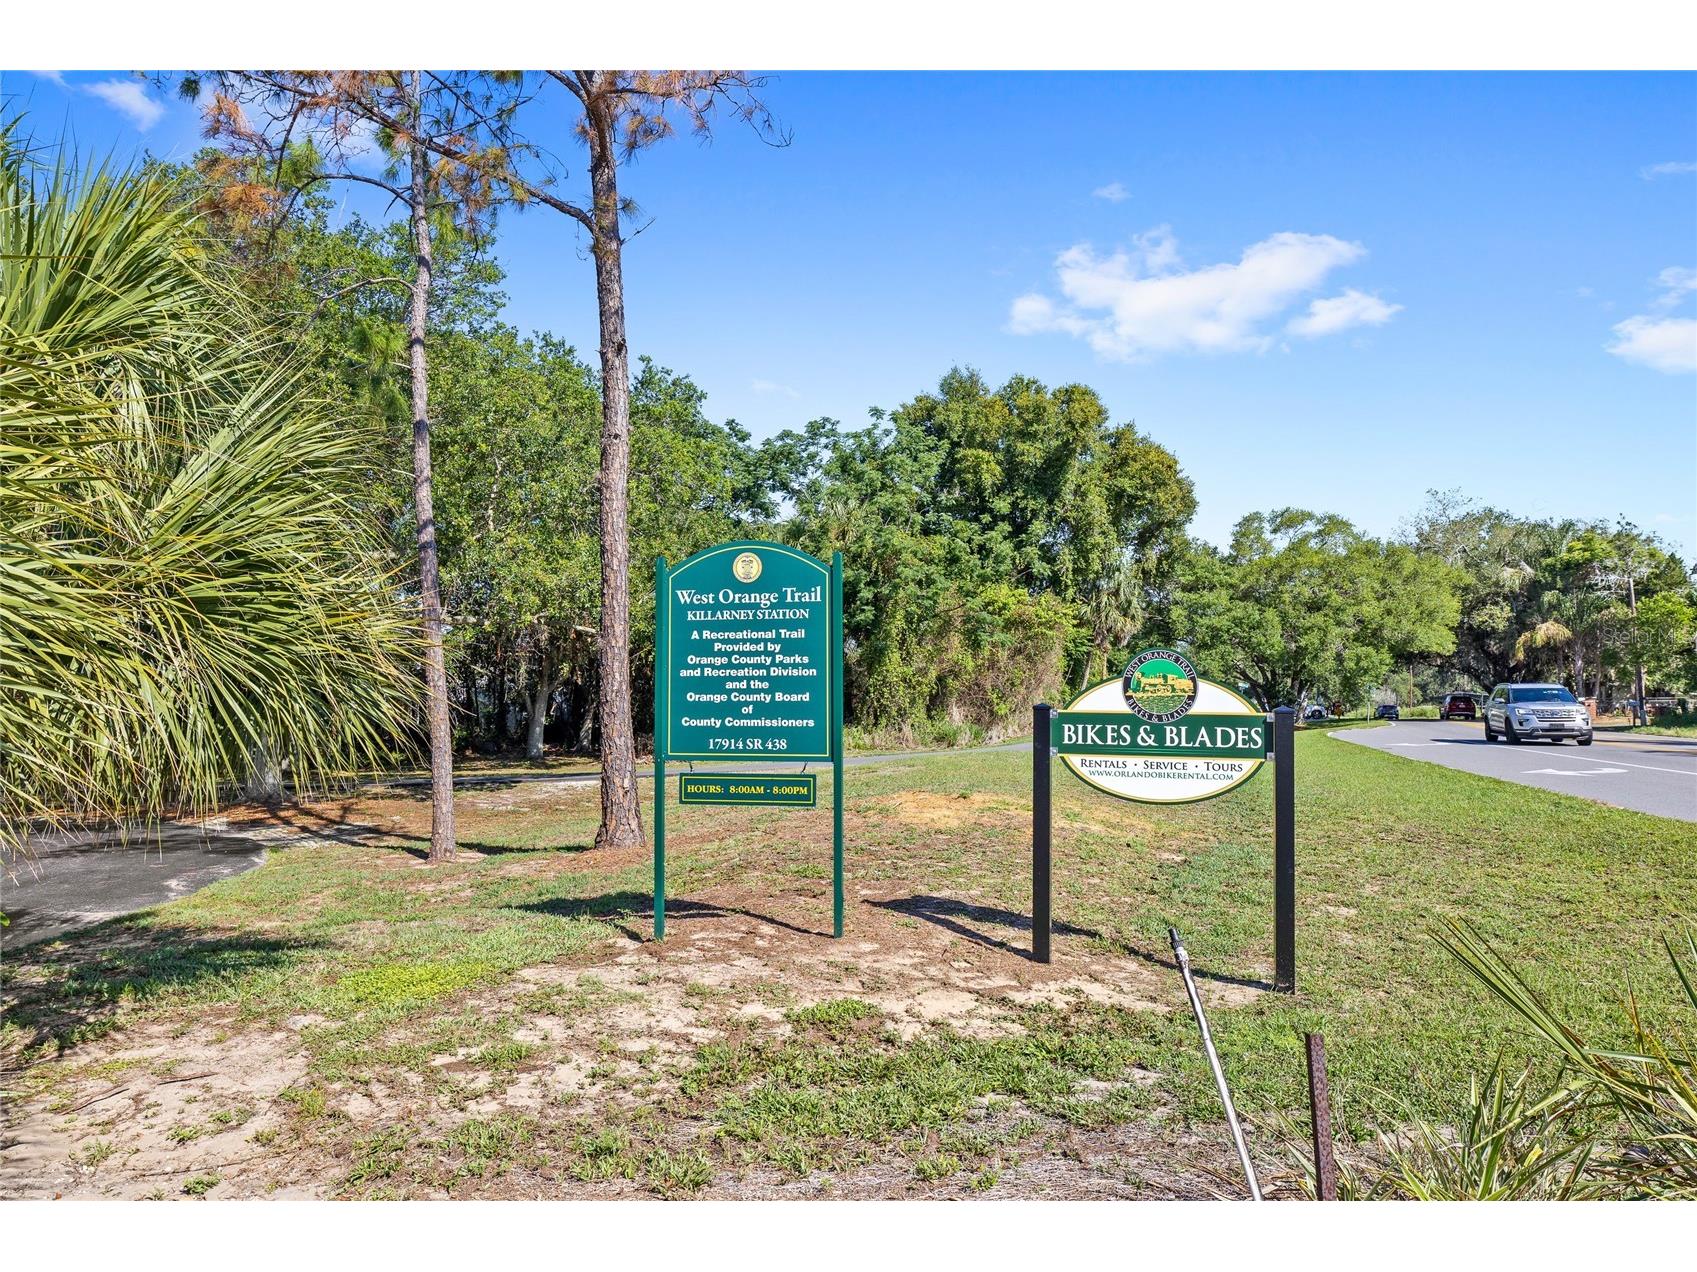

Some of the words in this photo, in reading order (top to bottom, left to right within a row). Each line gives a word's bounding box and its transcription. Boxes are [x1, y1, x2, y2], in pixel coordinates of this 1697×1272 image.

[675, 589, 715, 605] West
[718, 588, 779, 608] Orange
[782, 586, 822, 603] Trail
[687, 610, 755, 621] KILLARNEY
[756, 609, 809, 620] STATION
[691, 630, 699, 640] A
[702, 629, 776, 640] Recreational
[779, 629, 805, 639] Trail
[714, 642, 764, 652] Provided
[767, 642, 781, 653] by
[687, 655, 728, 666] Orange
[731, 655, 772, 666] County
[775, 654, 809, 664] Parks
[1125, 660, 1140, 678] WEST
[1141, 651, 1177, 662] ORANGE
[1177, 658, 1195, 678] TRAIL
[679, 668, 700, 677] and
[703, 667, 767, 677] Recreation
[770, 667, 817, 676] Division
[725, 680, 747, 689] and
[750, 680, 769, 689] the
[686, 692, 728, 703] Orange
[730, 692, 772, 703] County
[775, 692, 810, 702] Board
[741, 704, 754, 714] of
[1127, 698, 1150, 720] BIKES
[1162, 699, 1193, 721] BLADES
[681, 717, 722, 728] County
[724, 717, 815, 727] Commissioners
[1062, 723, 1131, 746] BIKES
[1136, 725, 1159, 747] &
[1163, 725, 1263, 749] BLADES
[708, 738, 743, 750] 17914
[745, 738, 763, 750] SR
[765, 738, 787, 750] 438
[687, 785, 725, 793] HOURS:
[729, 785, 764, 794] 8:00AM
[772, 786, 808, 795] 8:00PM
